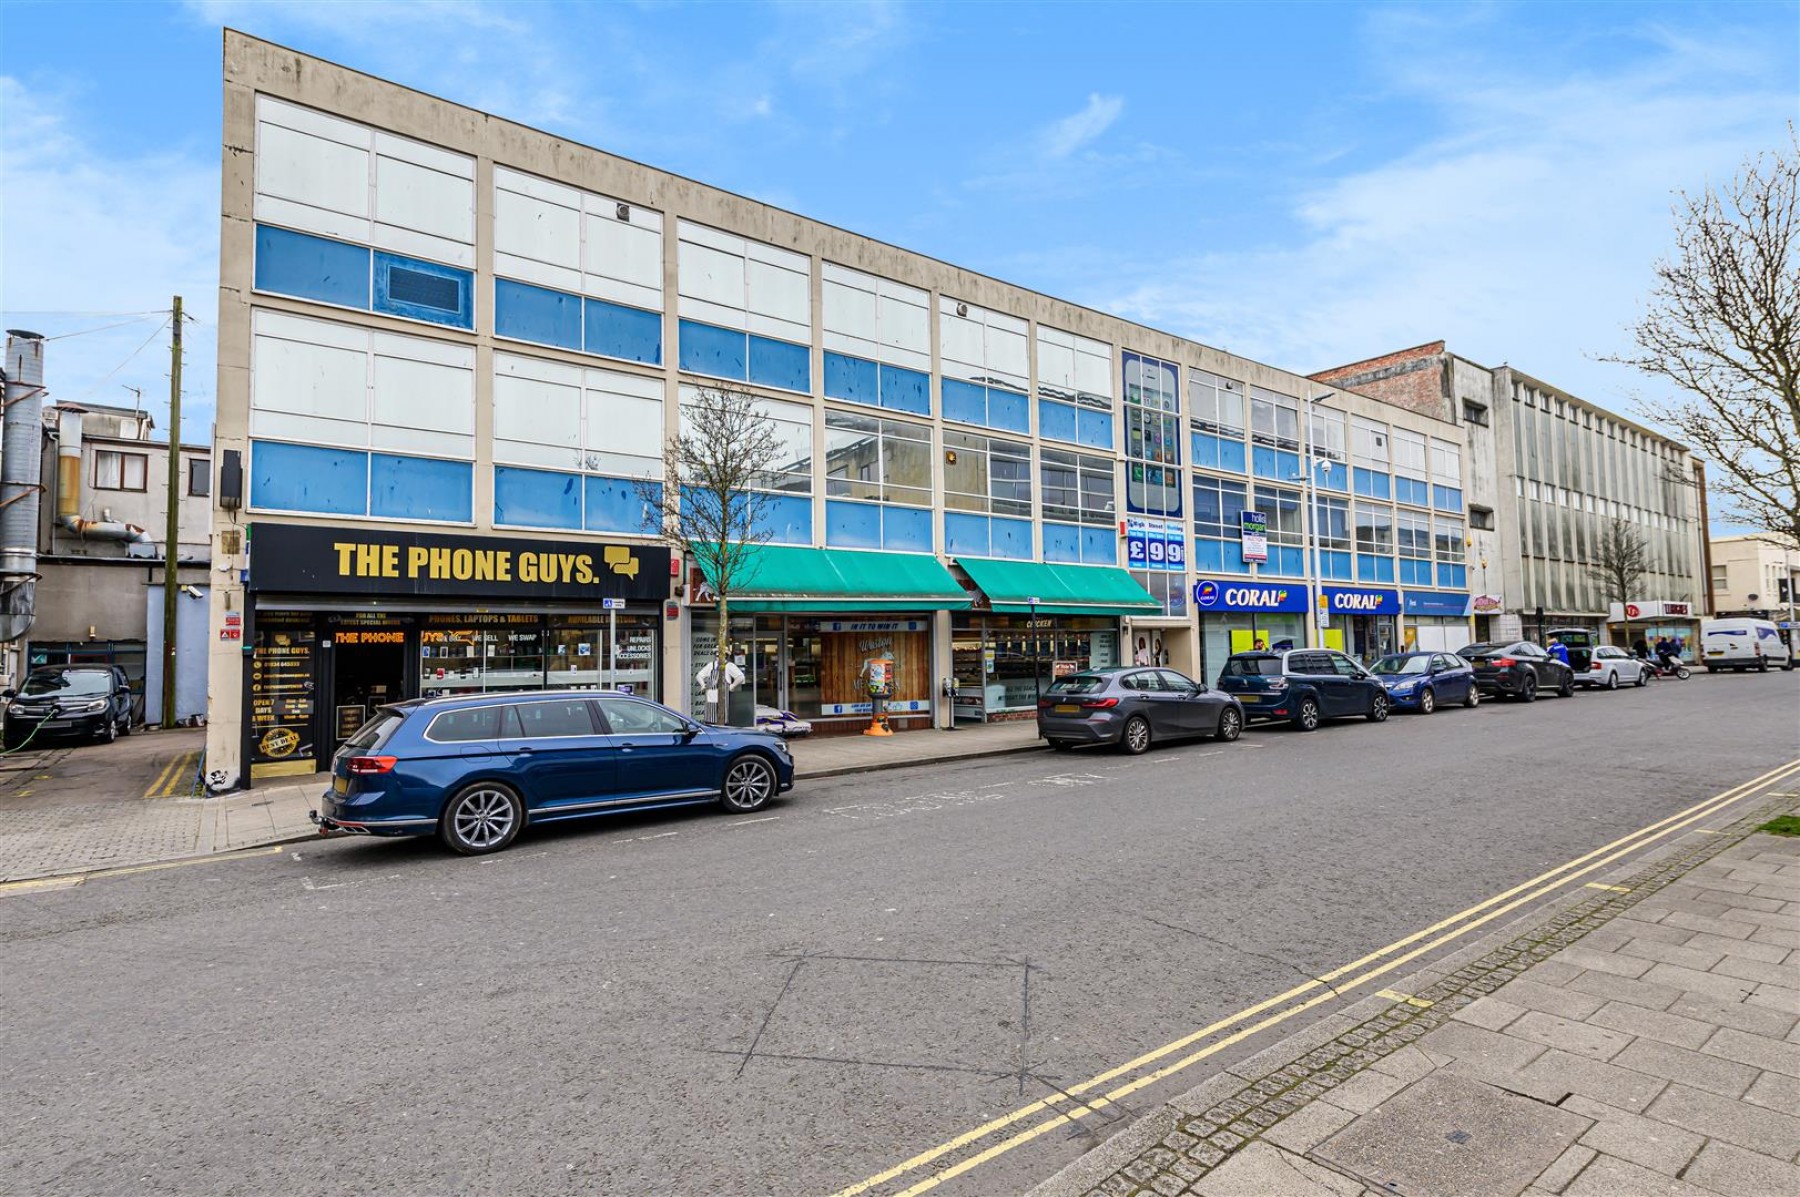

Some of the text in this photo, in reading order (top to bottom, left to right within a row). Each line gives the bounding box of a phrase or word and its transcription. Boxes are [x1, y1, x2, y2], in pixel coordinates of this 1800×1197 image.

[334, 543, 600, 584] THE PHONE GUYS.
[1225, 588, 1280, 607] CORAL
[1334, 593, 1377, 610] CORAL
[464, 615, 498, 623] LAPTOPS
[507, 615, 539, 623] TABLETS
[1026, 619, 1052, 628] CCKEN
[335, 632, 404, 643] THE PHONE
[508, 634, 518, 642] WE
[268, 647, 290, 655] PHONE
[261, 734, 297, 751] BEST DEAL
